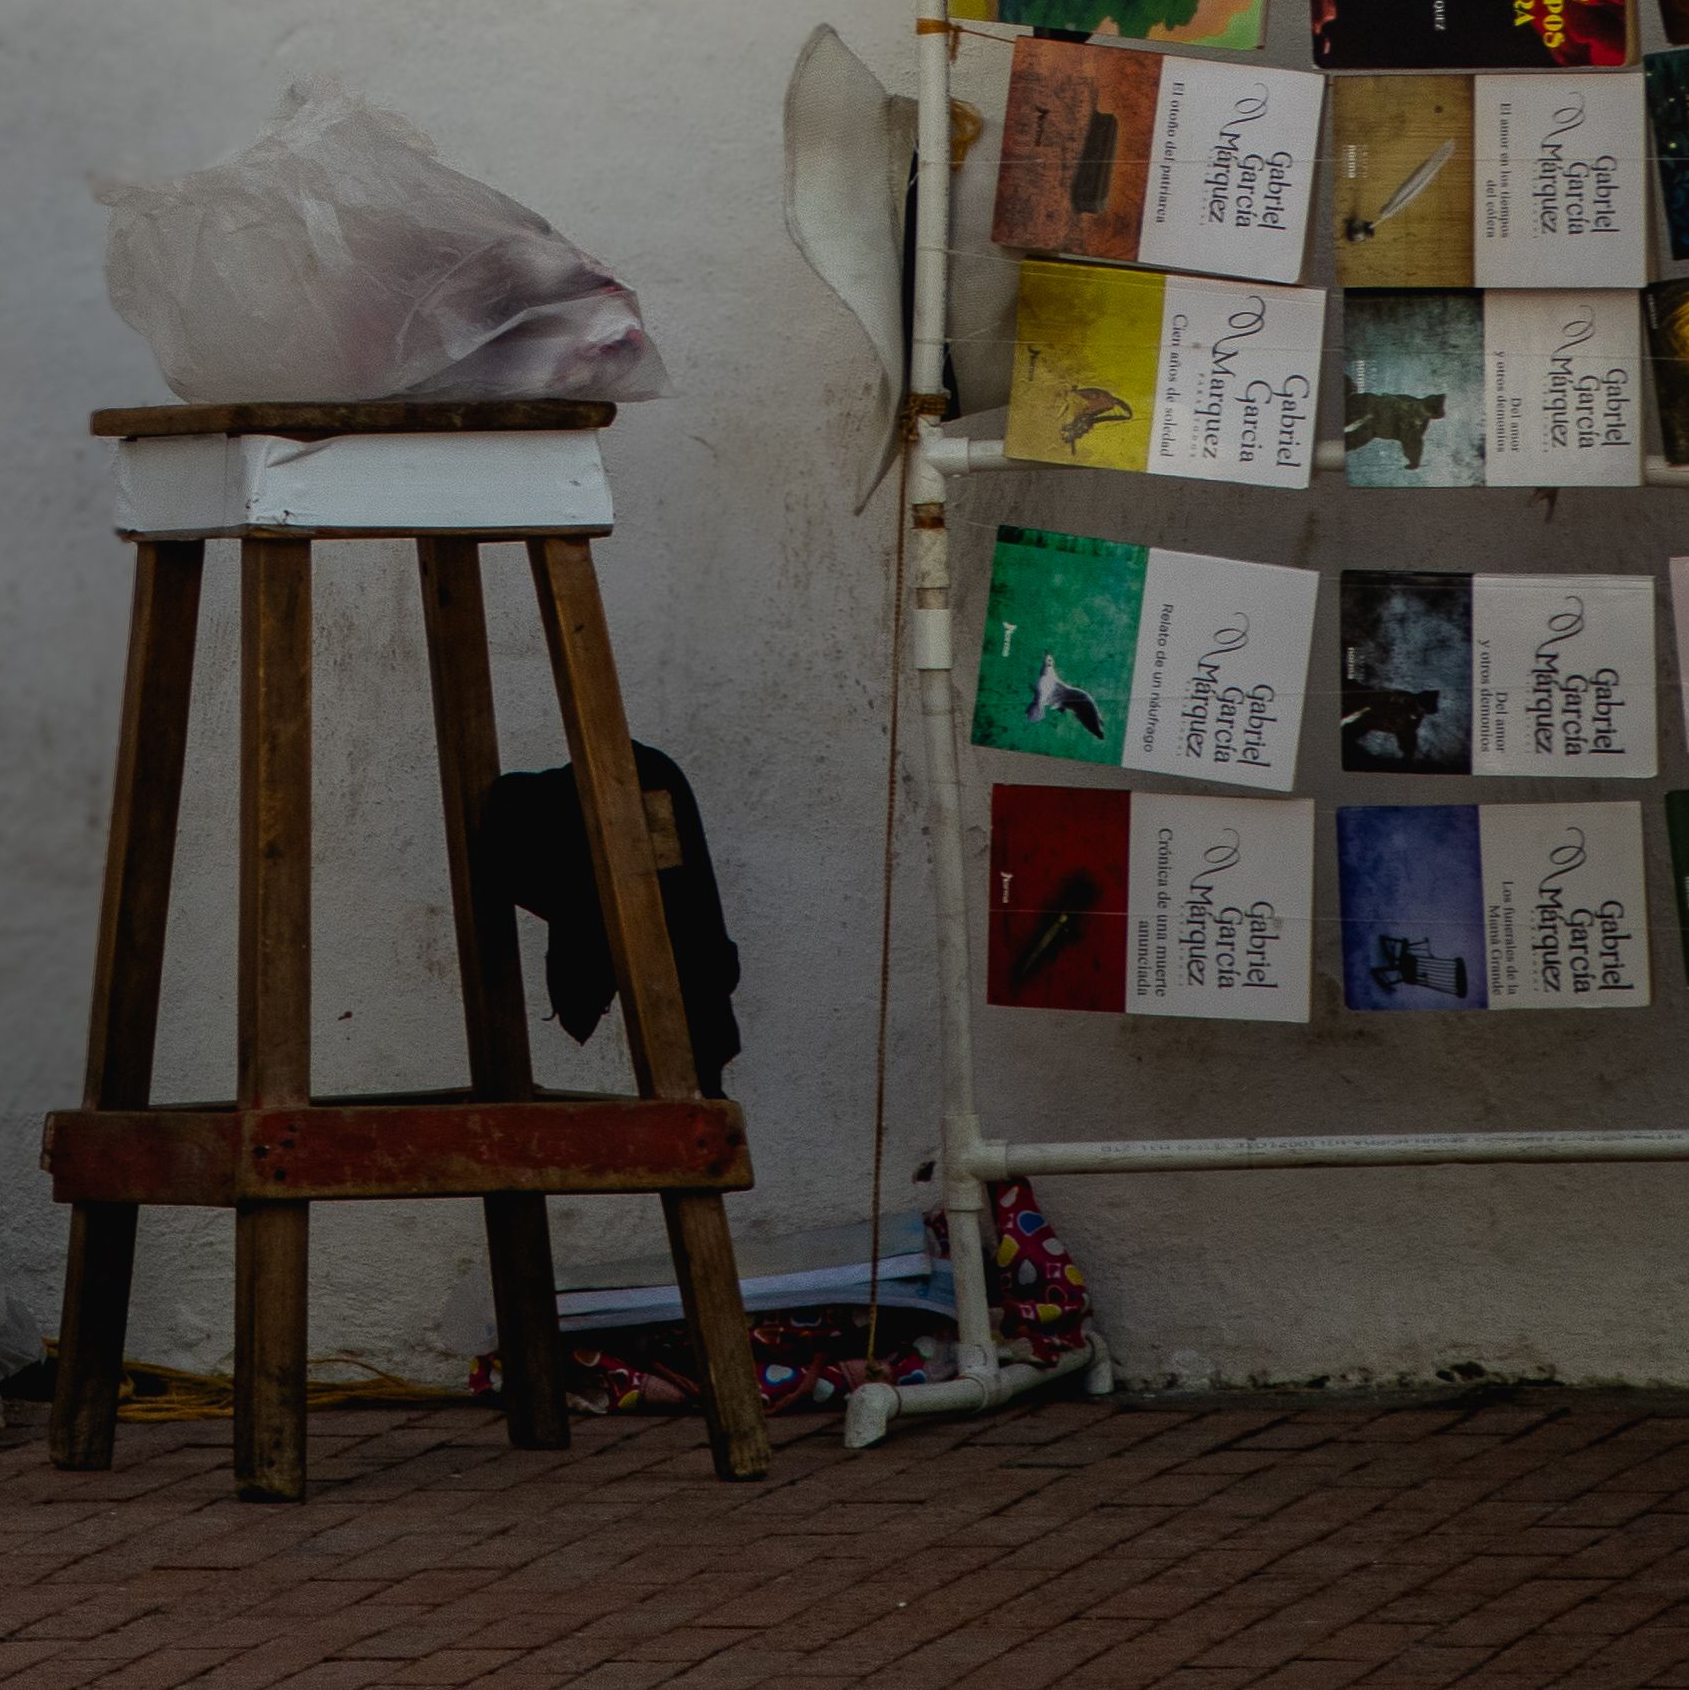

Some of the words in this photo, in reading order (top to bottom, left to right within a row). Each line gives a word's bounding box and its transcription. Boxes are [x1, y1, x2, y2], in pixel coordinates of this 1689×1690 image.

[1171, 81, 1185, 96] El
[1500, 103, 1512, 115] El
[1166, 100, 1182, 137] otoño
[1499, 119, 1510, 149] amor
[1164, 141, 1178, 162] del
[1499, 152, 1509, 167] en
[1156, 165, 1175, 223] patriarca
[1205, 131, 1241, 223] Márquez
[1235, 154, 1265, 228] García
[1257, 151, 1294, 230] Gabriel
[1486, 180, 1498, 198] del
[1500, 171, 1512, 188] los
[1532, 142, 1564, 234] Márquez
[1560, 162, 1589, 235] García
[1589, 155, 1620, 234] Gabriel
[1486, 201, 1498, 238] cólera
[1498, 191, 1512, 238] tiempos
[1171, 314, 1189, 347] Cien
[1167, 352, 1182, 383] años
[1496, 361, 1506, 392] otros
[1166, 387, 1182, 403] de
[1511, 397, 1522, 419] Del
[1543, 355, 1574, 448] Márquez
[1572, 375, 1601, 449] García
[1602, 368, 1631, 446] Gabriel
[1160, 408, 1180, 458] soledad
[1270, 374, 1311, 468] Gabriel
[1495, 395, 1508, 453] demonios
[1510, 422, 1521, 453] amor
[1157, 603, 1174, 647] Relato
[1478, 640, 1490, 648] y
[1151, 671, 1164, 688] un
[1154, 650, 1168, 668] de
[1480, 651, 1493, 685] otros
[1142, 692, 1162, 753] náufrago
[1181, 661, 1220, 758] Márquez
[1213, 687, 1246, 764] García
[1237, 684, 1277, 768] Gabriel
[1480, 688, 1494, 753] demonios
[1495, 692, 1509, 715] Del
[1526, 652, 1559, 754] Márquez
[1559, 674, 1588, 756] García
[1589, 668, 1625, 754] Gabriel
[1495, 718, 1507, 753] amor
[1157, 828, 1174, 887] Crónica
[1156, 891, 1172, 909] de
[1502, 881, 1515, 903] Los
[1156, 914, 1168, 941] una
[1179, 882, 1215, 986] Márquez
[1214, 907, 1244, 989] García
[1242, 901, 1280, 989] Gabriel
[1488, 905, 1504, 945] Mamá
[1502, 907, 1517, 962] funerales
[1531, 886, 1563, 992] Márquez
[1594, 900, 1634, 991] Gabriel
[1137, 920, 1152, 996] anunciada
[1155, 945, 1168, 997] muerte
[1490, 949, 1503, 996] Grande
[1506, 966, 1519, 981] de
[1564, 909, 1596, 993] García
[1506, 984, 1519, 995] la
